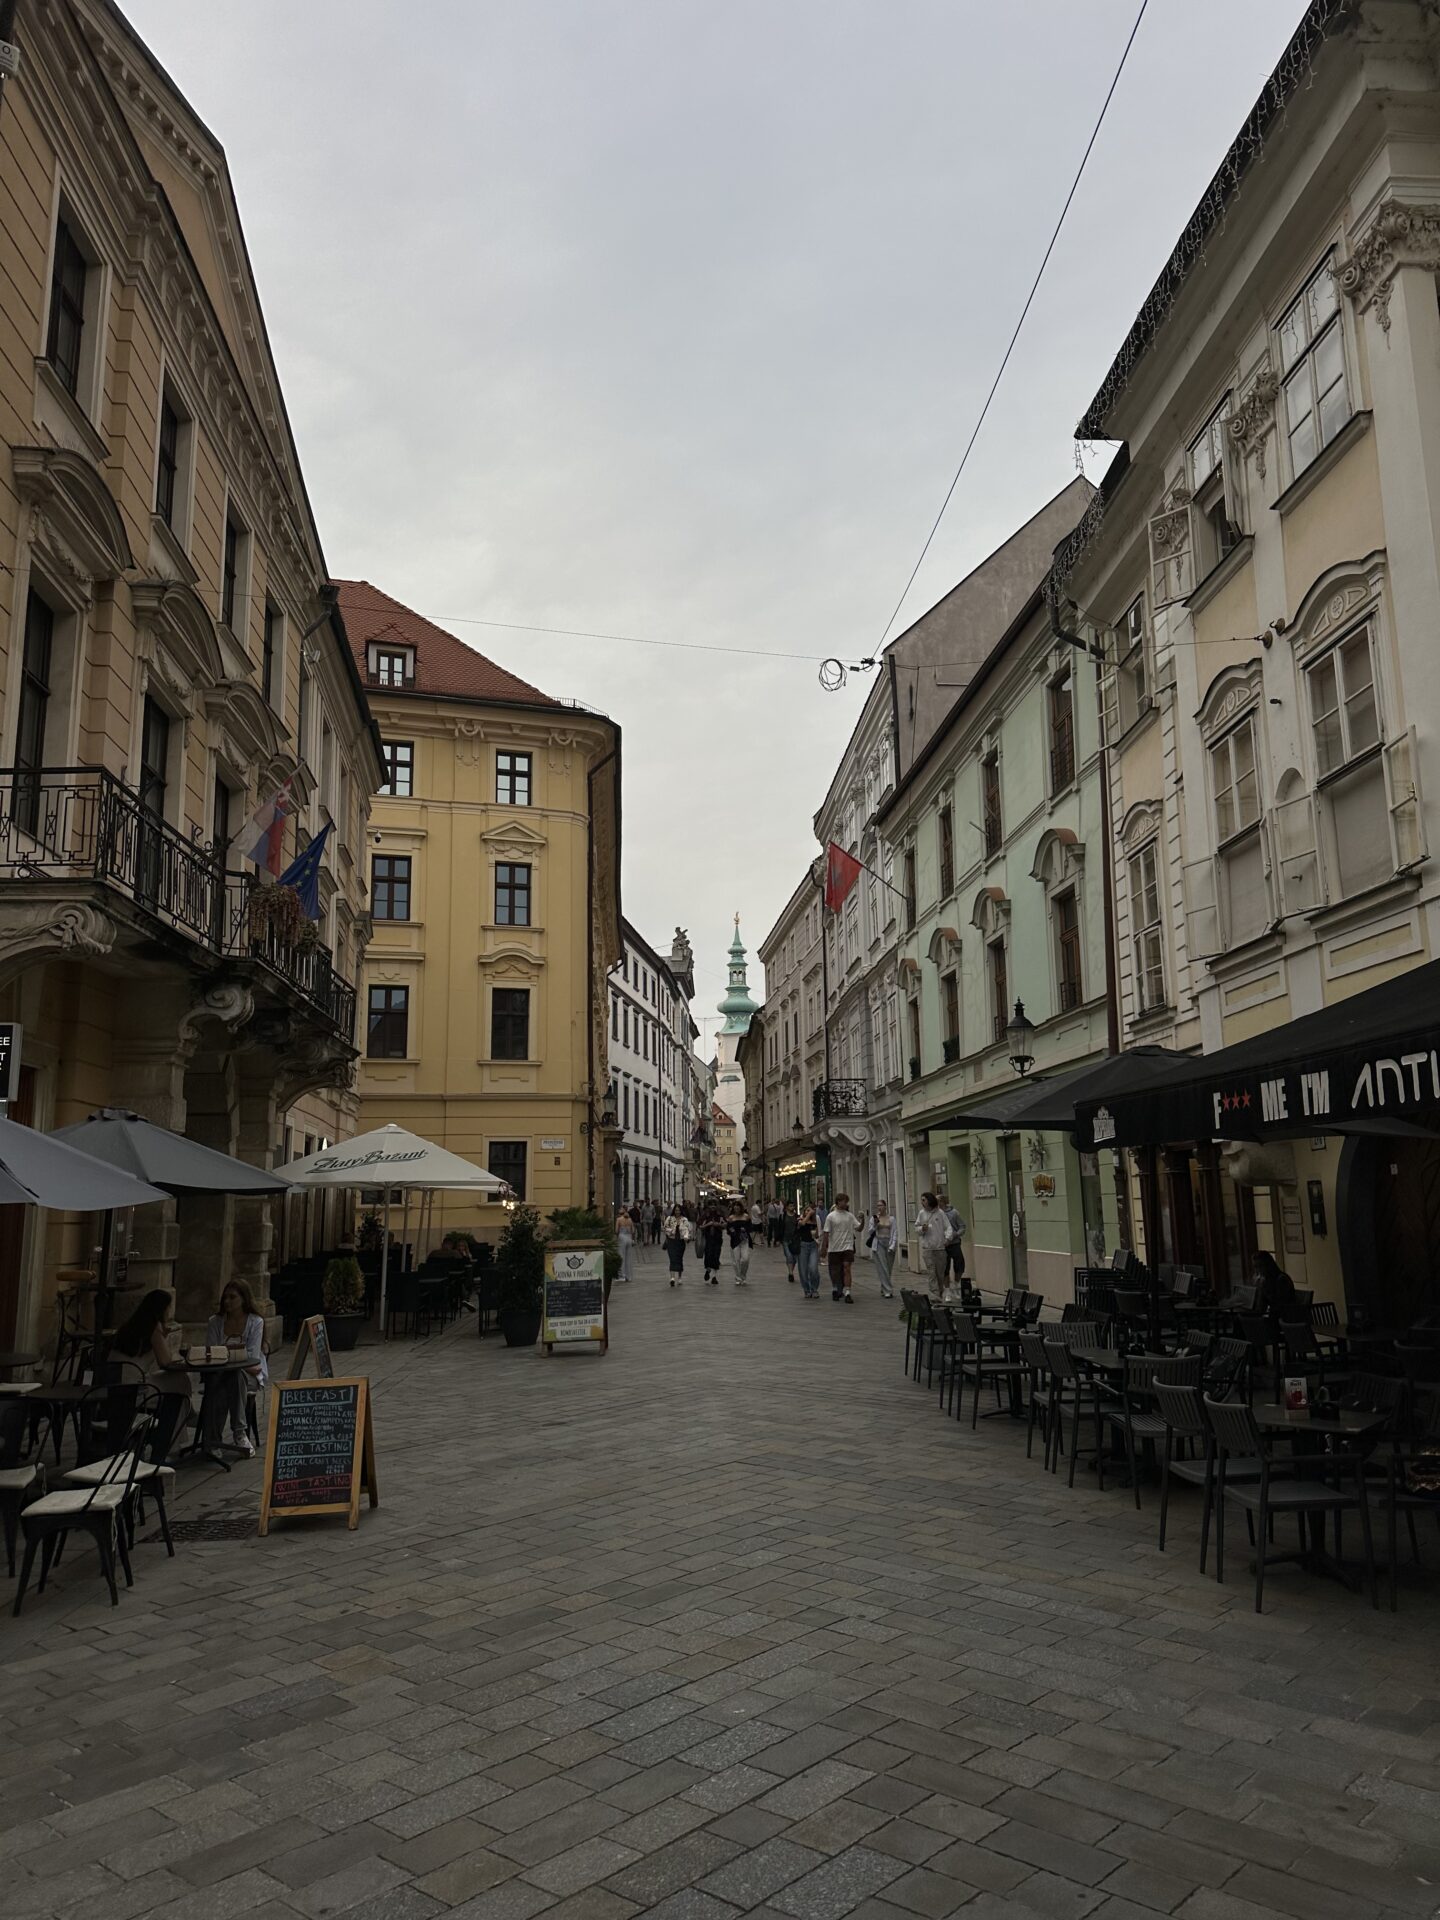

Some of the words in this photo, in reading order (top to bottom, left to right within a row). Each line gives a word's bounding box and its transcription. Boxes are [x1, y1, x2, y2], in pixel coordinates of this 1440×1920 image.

[1260, 1077, 1289, 1122] ME
[1300, 1070, 1330, 1116] I'M
[286, 1389, 348, 1403] BREKFAST
[281, 1444, 304, 1455] BEER
[310, 1442, 349, 1453] TASTING
